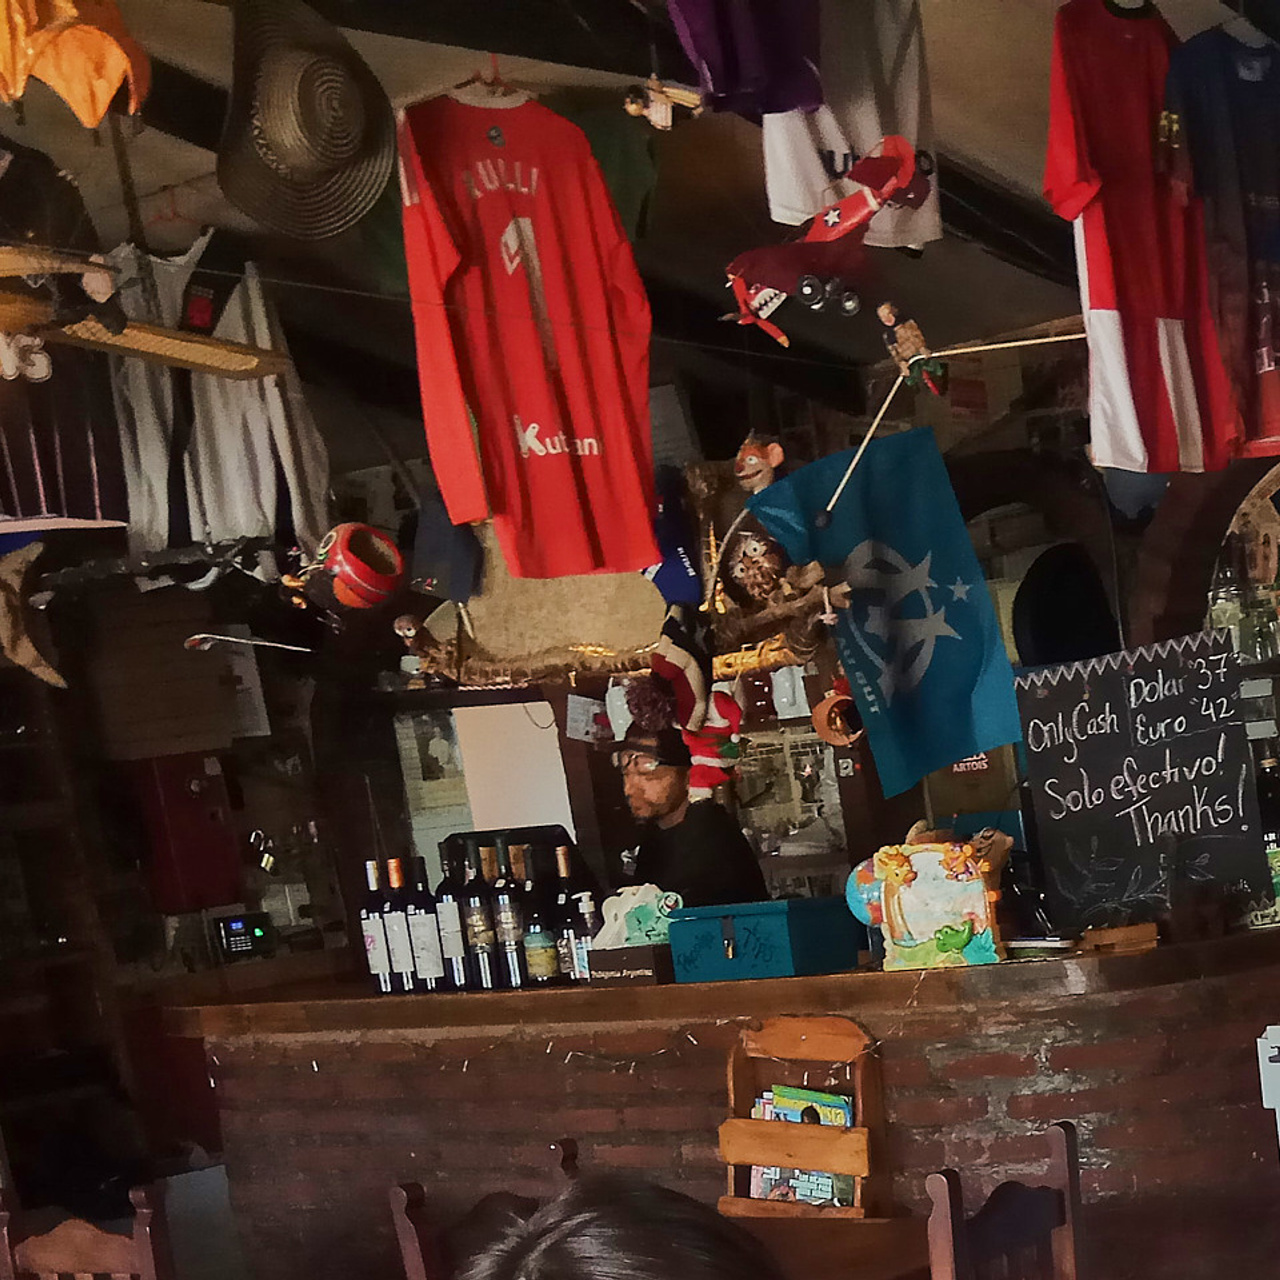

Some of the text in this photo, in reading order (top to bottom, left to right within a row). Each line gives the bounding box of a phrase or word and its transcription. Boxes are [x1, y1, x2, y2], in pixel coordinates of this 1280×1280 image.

[1129, 669, 1188, 709] Dolar
[1028, 702, 1119, 763] Only Cash
[1135, 713, 1187, 745] Euro
[953, 758, 989, 773] ARTOIS
[1044, 732, 1228, 819] Solo efectivo!
[1114, 763, 1249, 846] Thanks!
